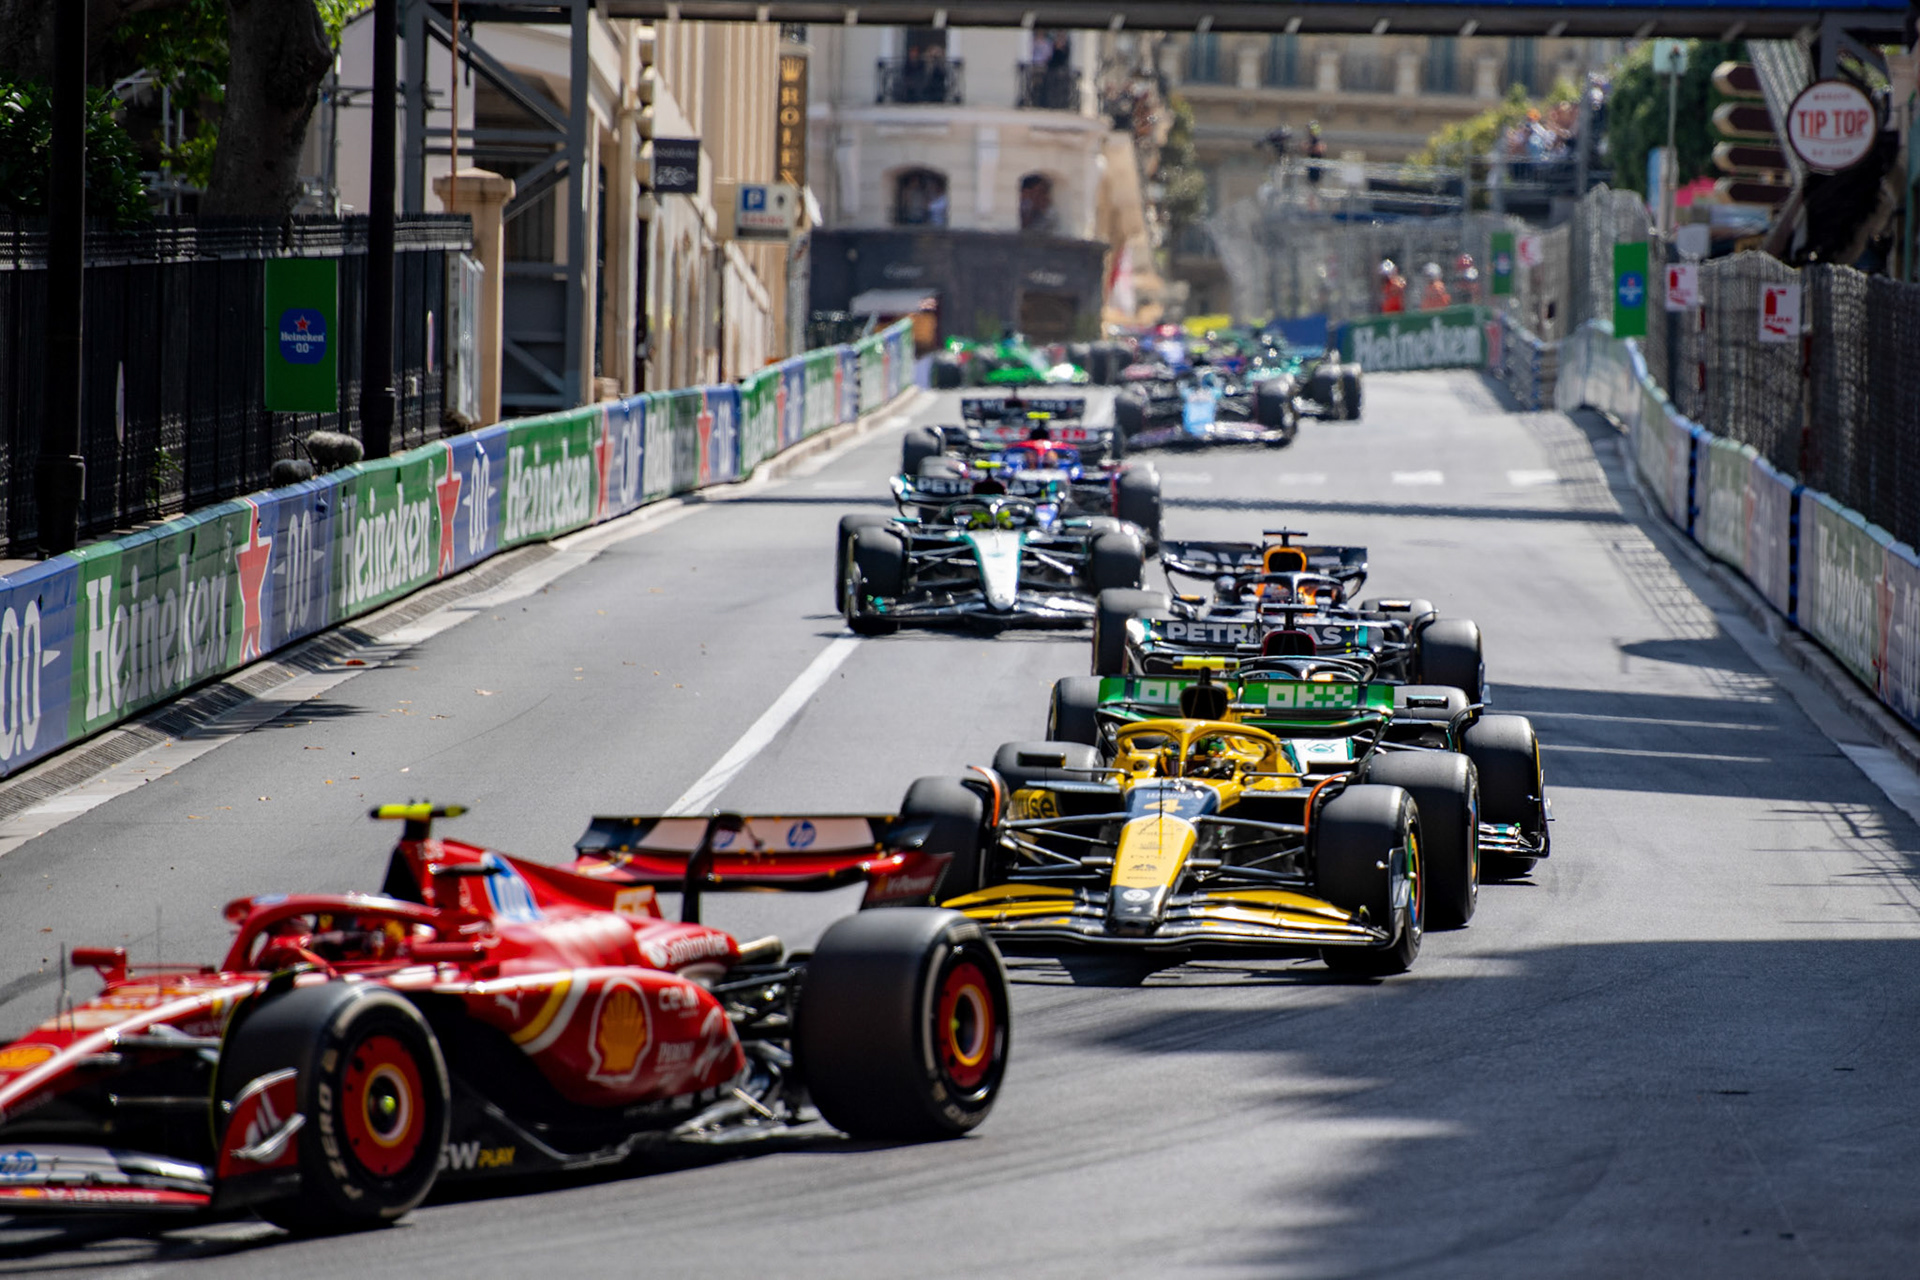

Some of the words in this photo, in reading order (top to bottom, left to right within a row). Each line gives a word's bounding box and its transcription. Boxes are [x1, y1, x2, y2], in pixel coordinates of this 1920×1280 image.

[1798, 110, 1827, 137] TIP
[1832, 109, 1870, 137] TOP
[281, 331, 325, 342] Heineken
[1353, 316, 1482, 371] Heineken
[504, 438, 591, 541] Heineken
[917, 478, 1042, 496] PETRAS
[340, 482, 430, 608] Heineken
[86, 552, 228, 722] Heineken
[1267, 684, 1353, 708] OKX
[1143, 799, 1184, 813] 4
